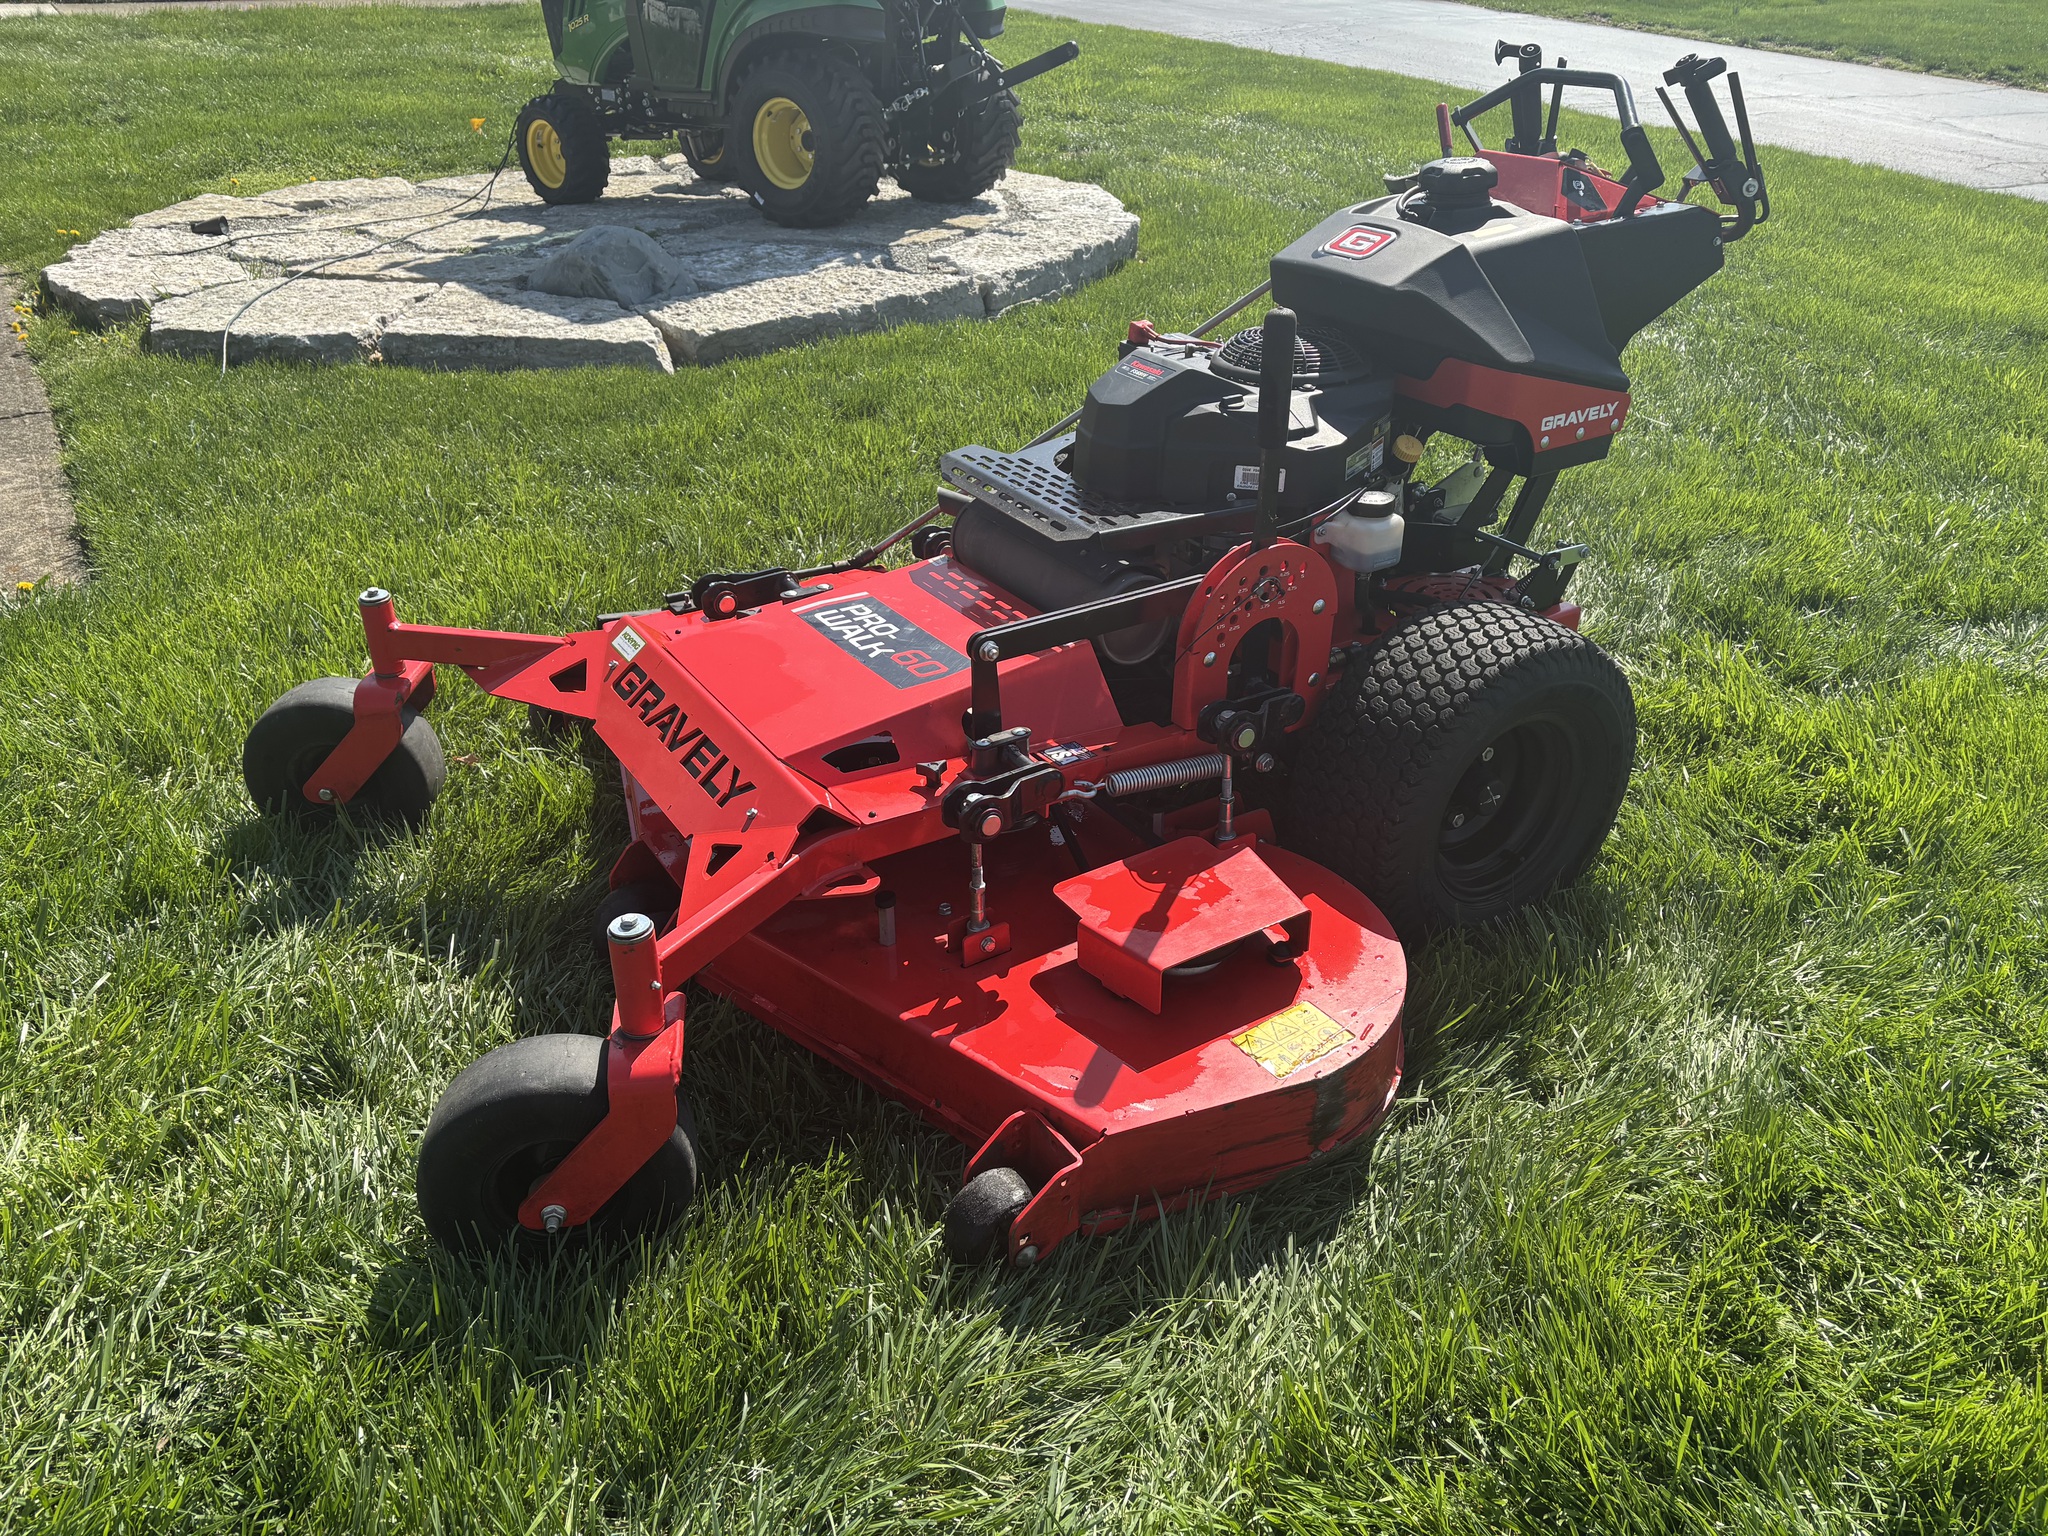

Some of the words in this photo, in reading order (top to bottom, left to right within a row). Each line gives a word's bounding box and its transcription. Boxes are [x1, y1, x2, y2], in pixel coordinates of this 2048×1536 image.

[1541, 401, 1619, 432] GRAVELY
[813, 609, 896, 658] WALK
[890, 649, 949, 678] 60
[839, 603, 901, 640] PRO-
[611, 661, 757, 809] GRAVELY
